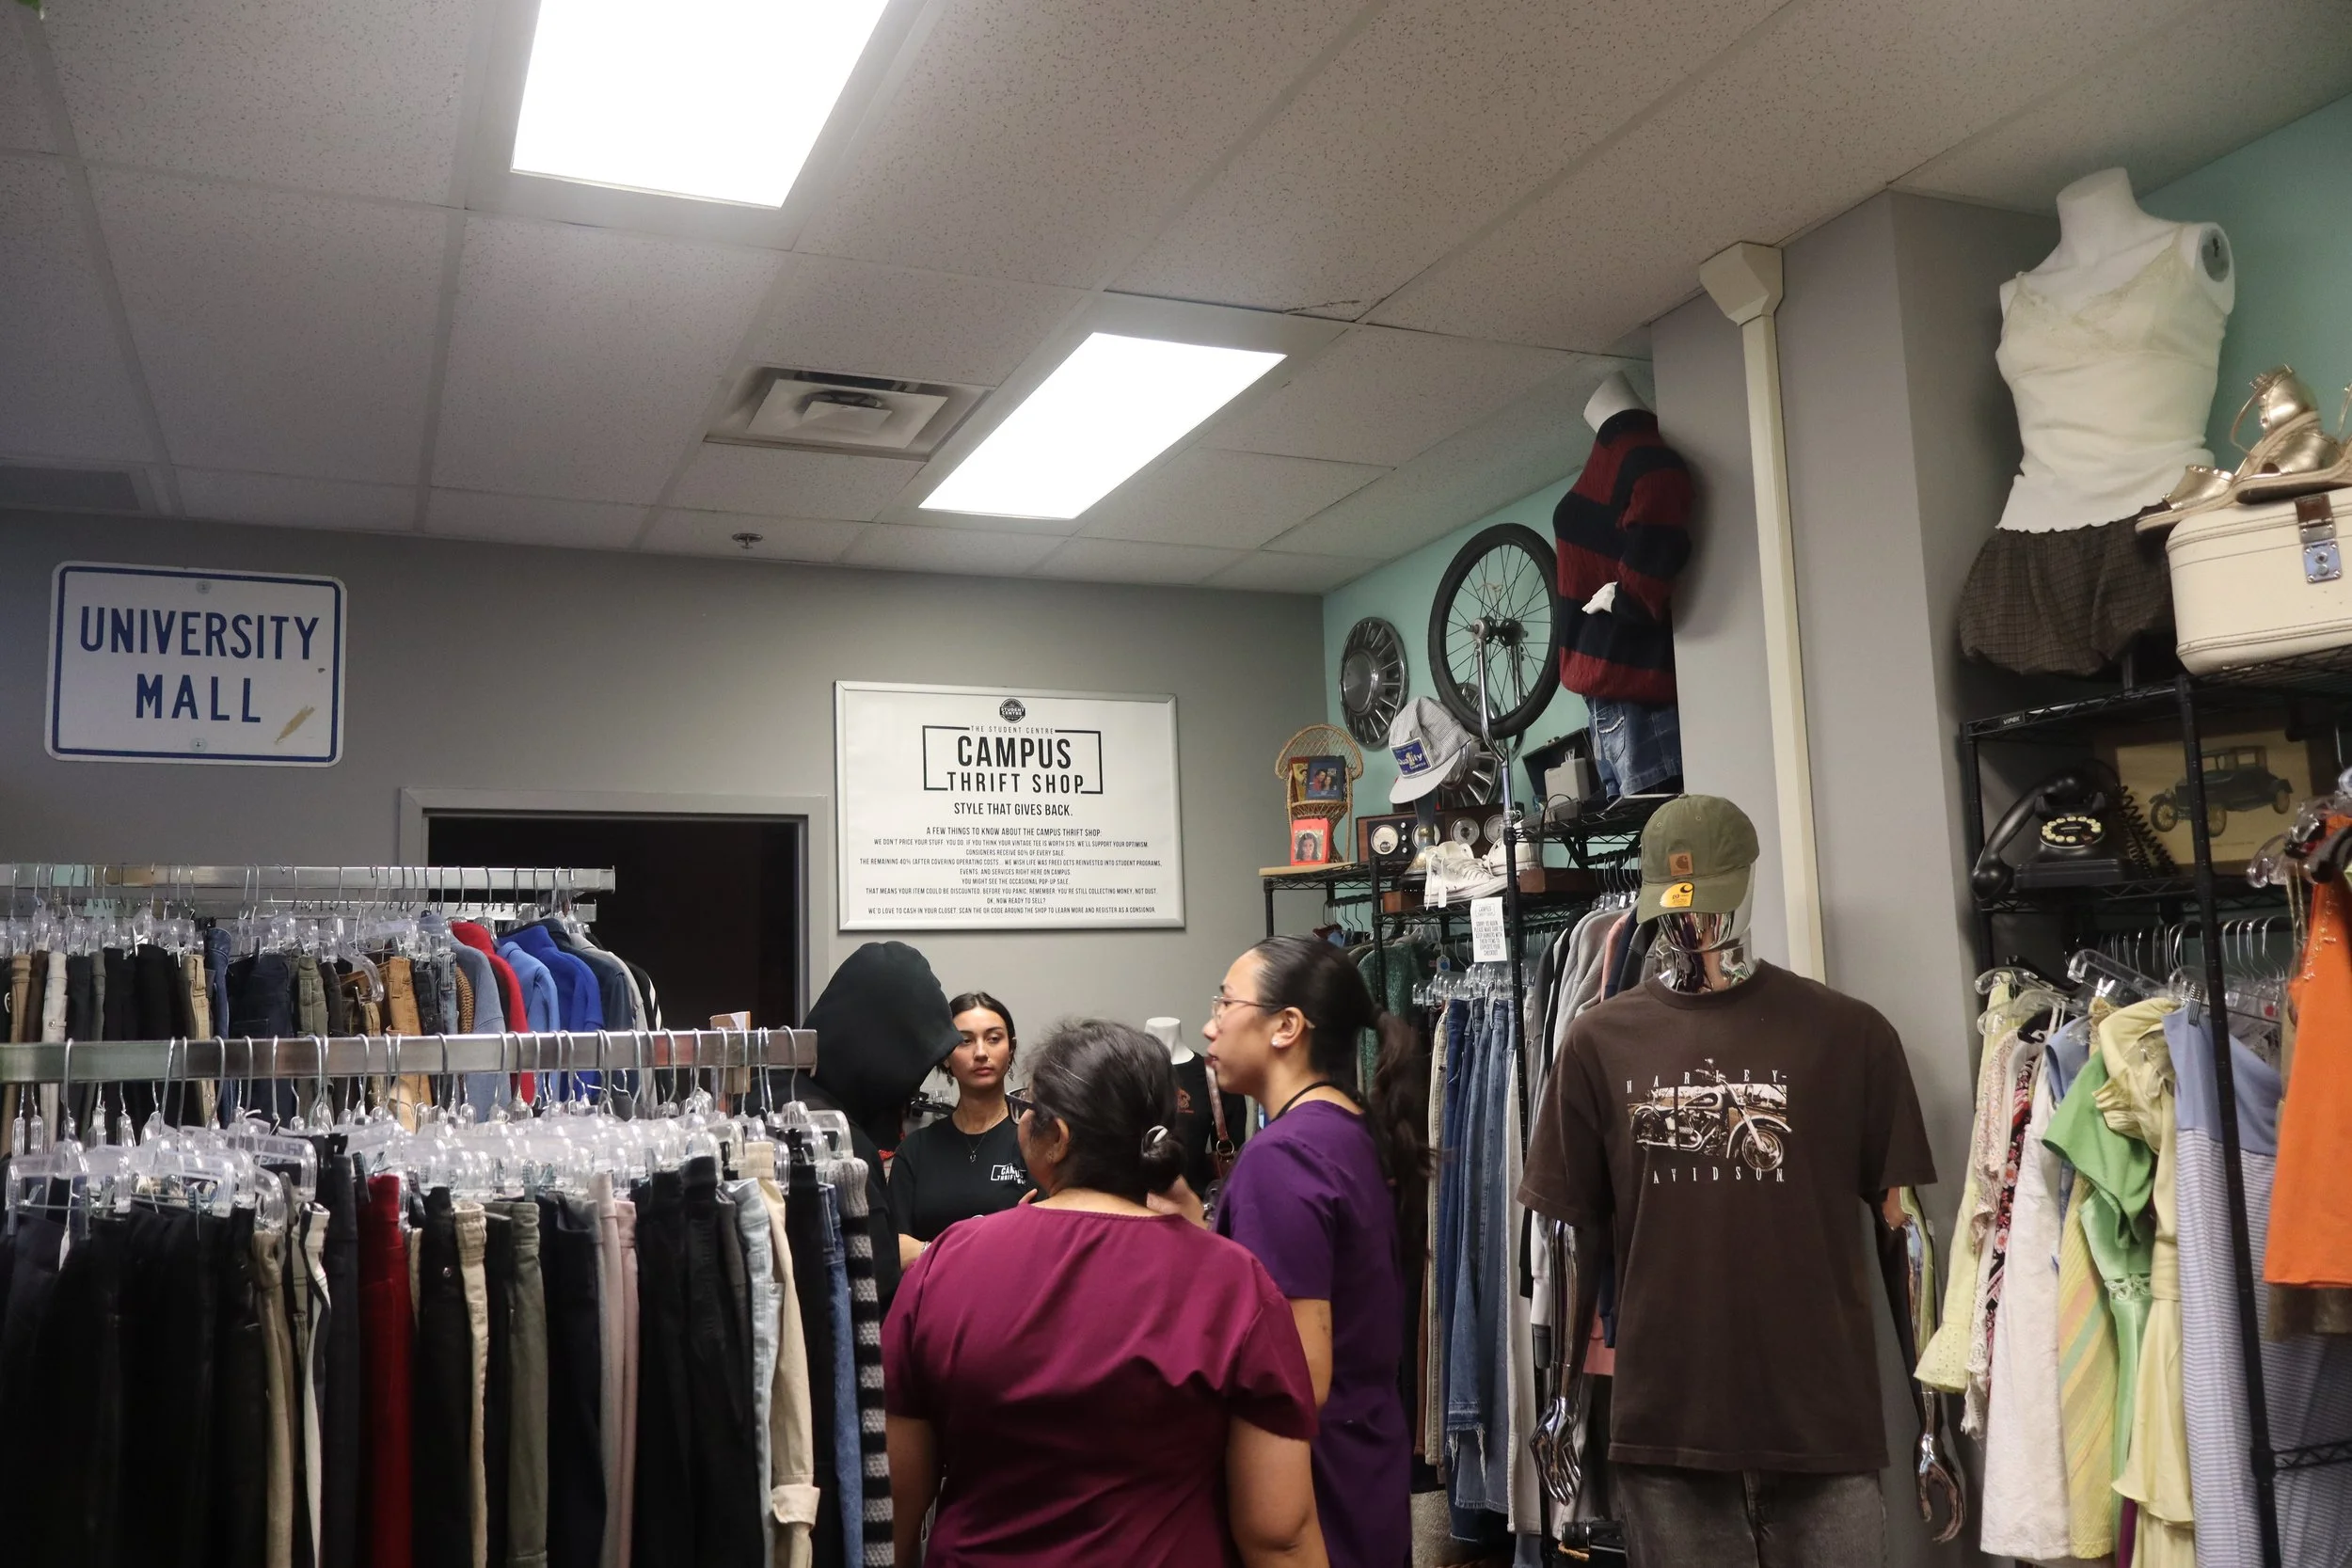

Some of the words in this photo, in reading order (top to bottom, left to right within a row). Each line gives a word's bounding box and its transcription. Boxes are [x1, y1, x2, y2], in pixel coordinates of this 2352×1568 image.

[80, 606, 319, 659] UNIVERSITY
[135, 673, 261, 722] MALL
[958, 736, 1072, 768] CAMPUS
[947, 771, 1020, 792] THRIFT
[1032, 774, 1084, 794] SHOP
[954, 802, 983, 815] STYLE
[987, 803, 1011, 815] THAT
[1014, 803, 1042, 816] GIVES
[1045, 804, 1073, 816] BACK.
[927, 827, 930, 835] A
[932, 827, 946, 835] FEW
[947, 828, 970, 836] THINGS
[972, 828, 980, 836] TO
[981, 828, 1000, 836] KNOW
[1001, 828, 1021, 836] ABOUT
[1024, 828, 1035, 836] THE
[1062, 829, 1083, 837] THRIFT
[1653, 1166, 1784, 1183] AVIDSON.
